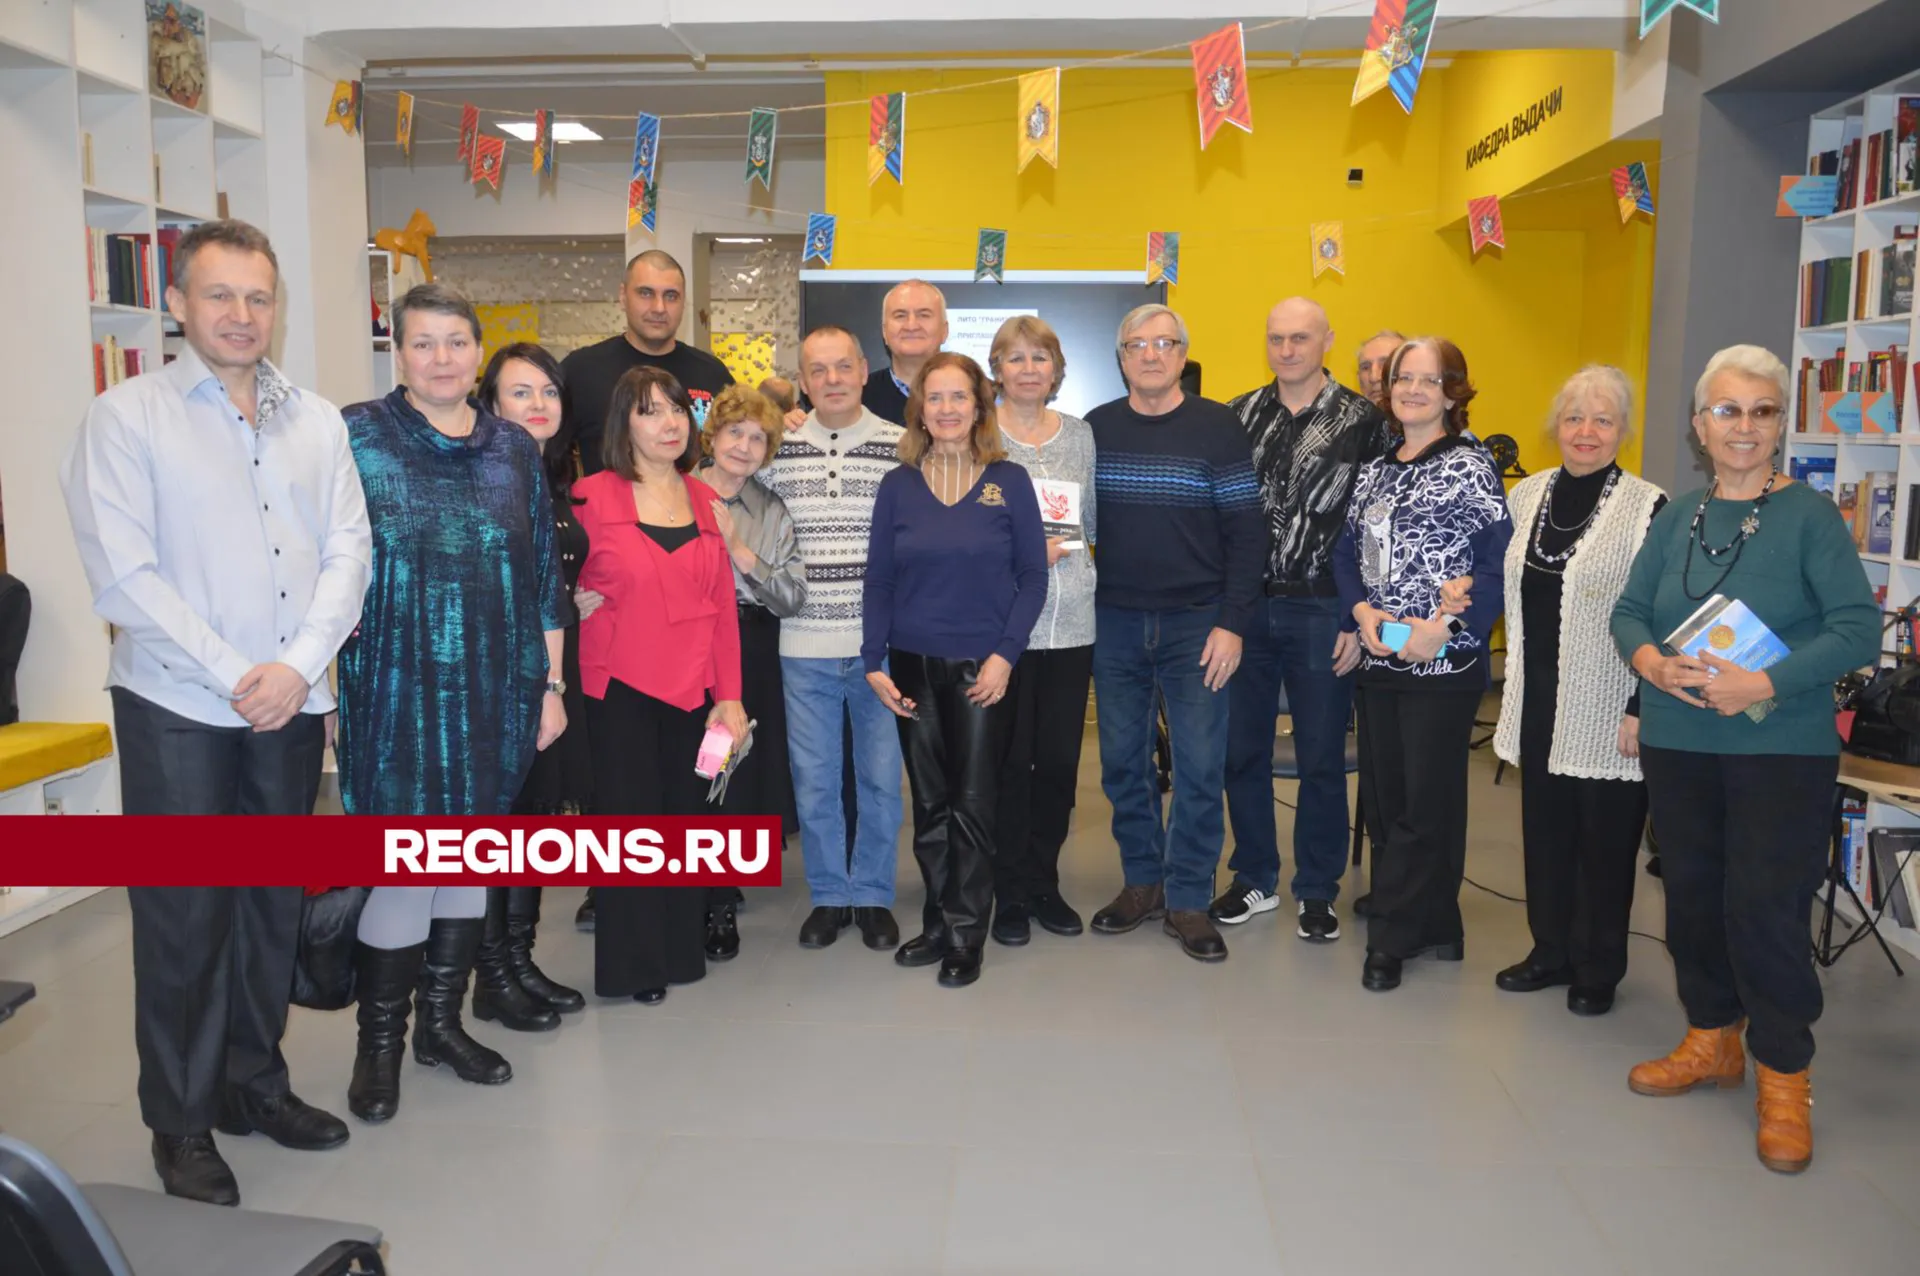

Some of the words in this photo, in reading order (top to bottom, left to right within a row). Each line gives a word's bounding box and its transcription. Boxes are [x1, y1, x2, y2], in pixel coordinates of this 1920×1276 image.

[1465, 122, 1510, 170] КАФЕДРА
[1511, 85, 1562, 141] ВЫДАЧИ
[957, 331, 996, 339] ПРИГЛАШ
